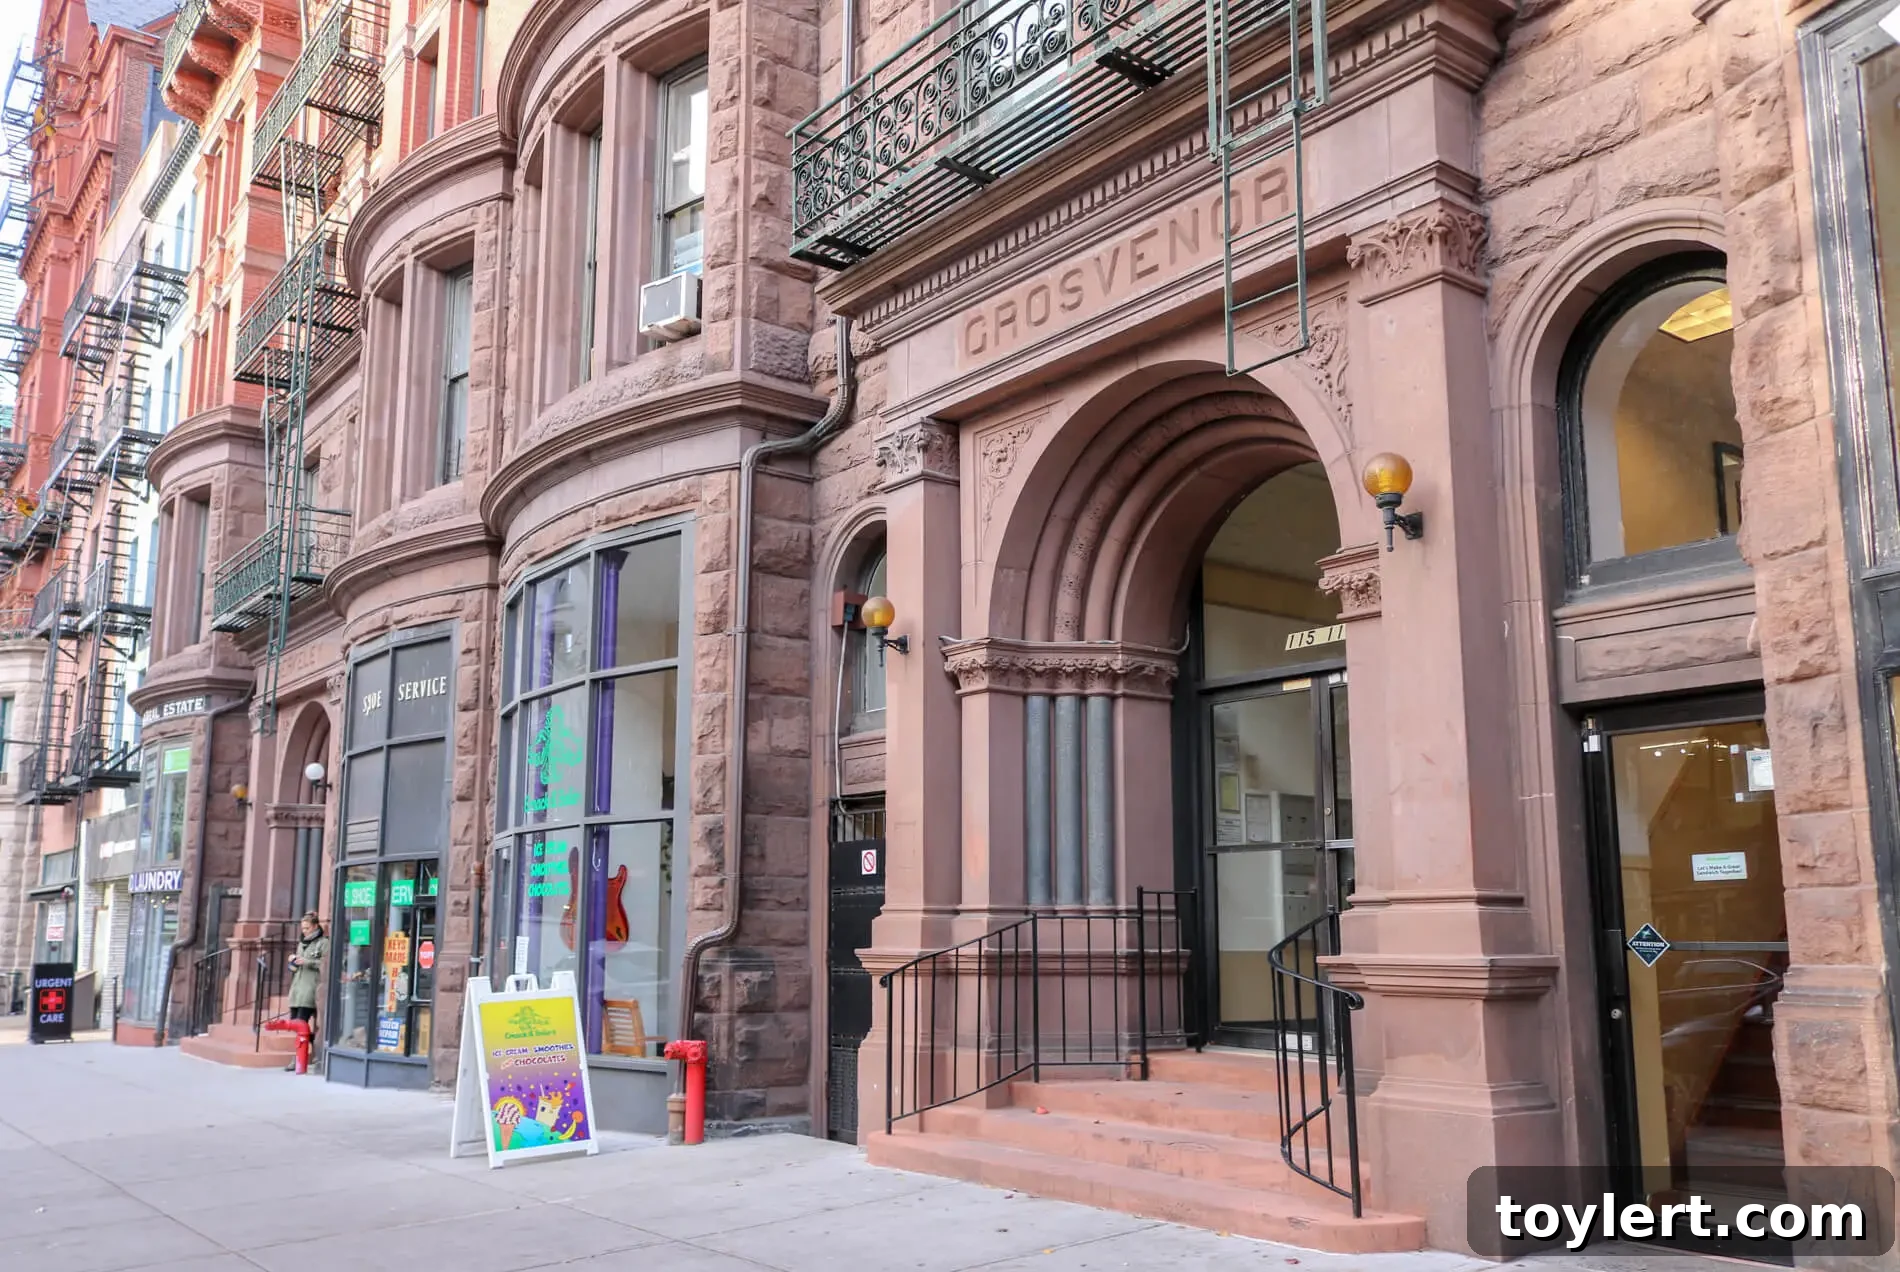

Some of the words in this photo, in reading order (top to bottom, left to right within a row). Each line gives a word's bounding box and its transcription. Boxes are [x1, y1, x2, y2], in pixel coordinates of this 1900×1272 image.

[964, 165, 1290, 356] GROSVENOR
[1289, 630, 1316, 648] 115
[1327, 625, 1343, 641] 11
[398, 676, 447, 701] SERVICE
[163, 697, 203, 716] ESTATE
[134, 870, 182, 891] LAUNDRY
[35, 978, 73, 989] URGENT
[40, 1013, 65, 1023] CARE
[514, 1055, 566, 1066] CHOCOLATES
